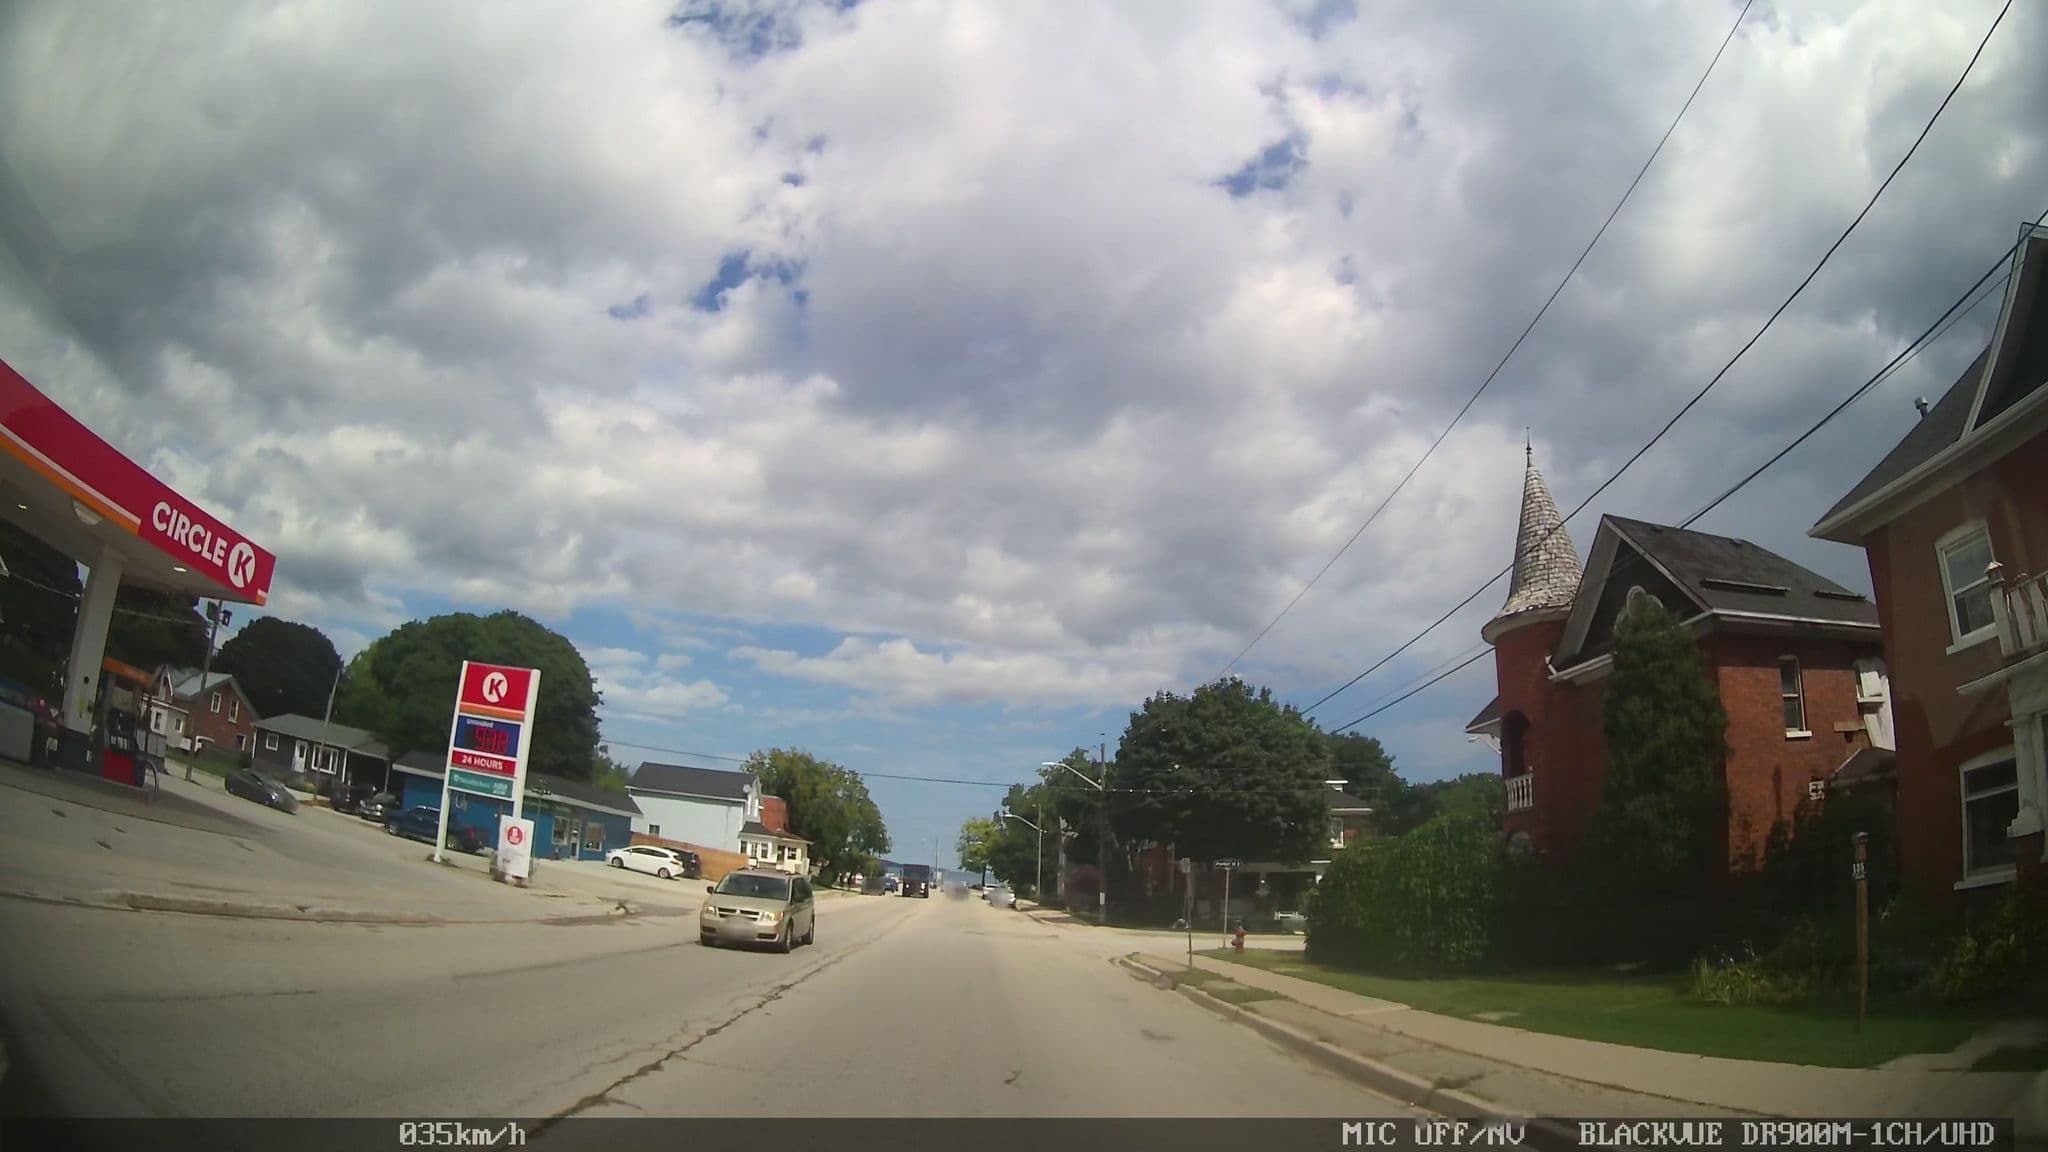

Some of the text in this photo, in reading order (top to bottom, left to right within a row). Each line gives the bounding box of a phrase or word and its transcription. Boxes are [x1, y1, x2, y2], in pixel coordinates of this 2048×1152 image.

[153, 501, 254, 588] CIRCLE K
[485, 675, 505, 702] K
[462, 755, 503, 770] 24 HOURS
